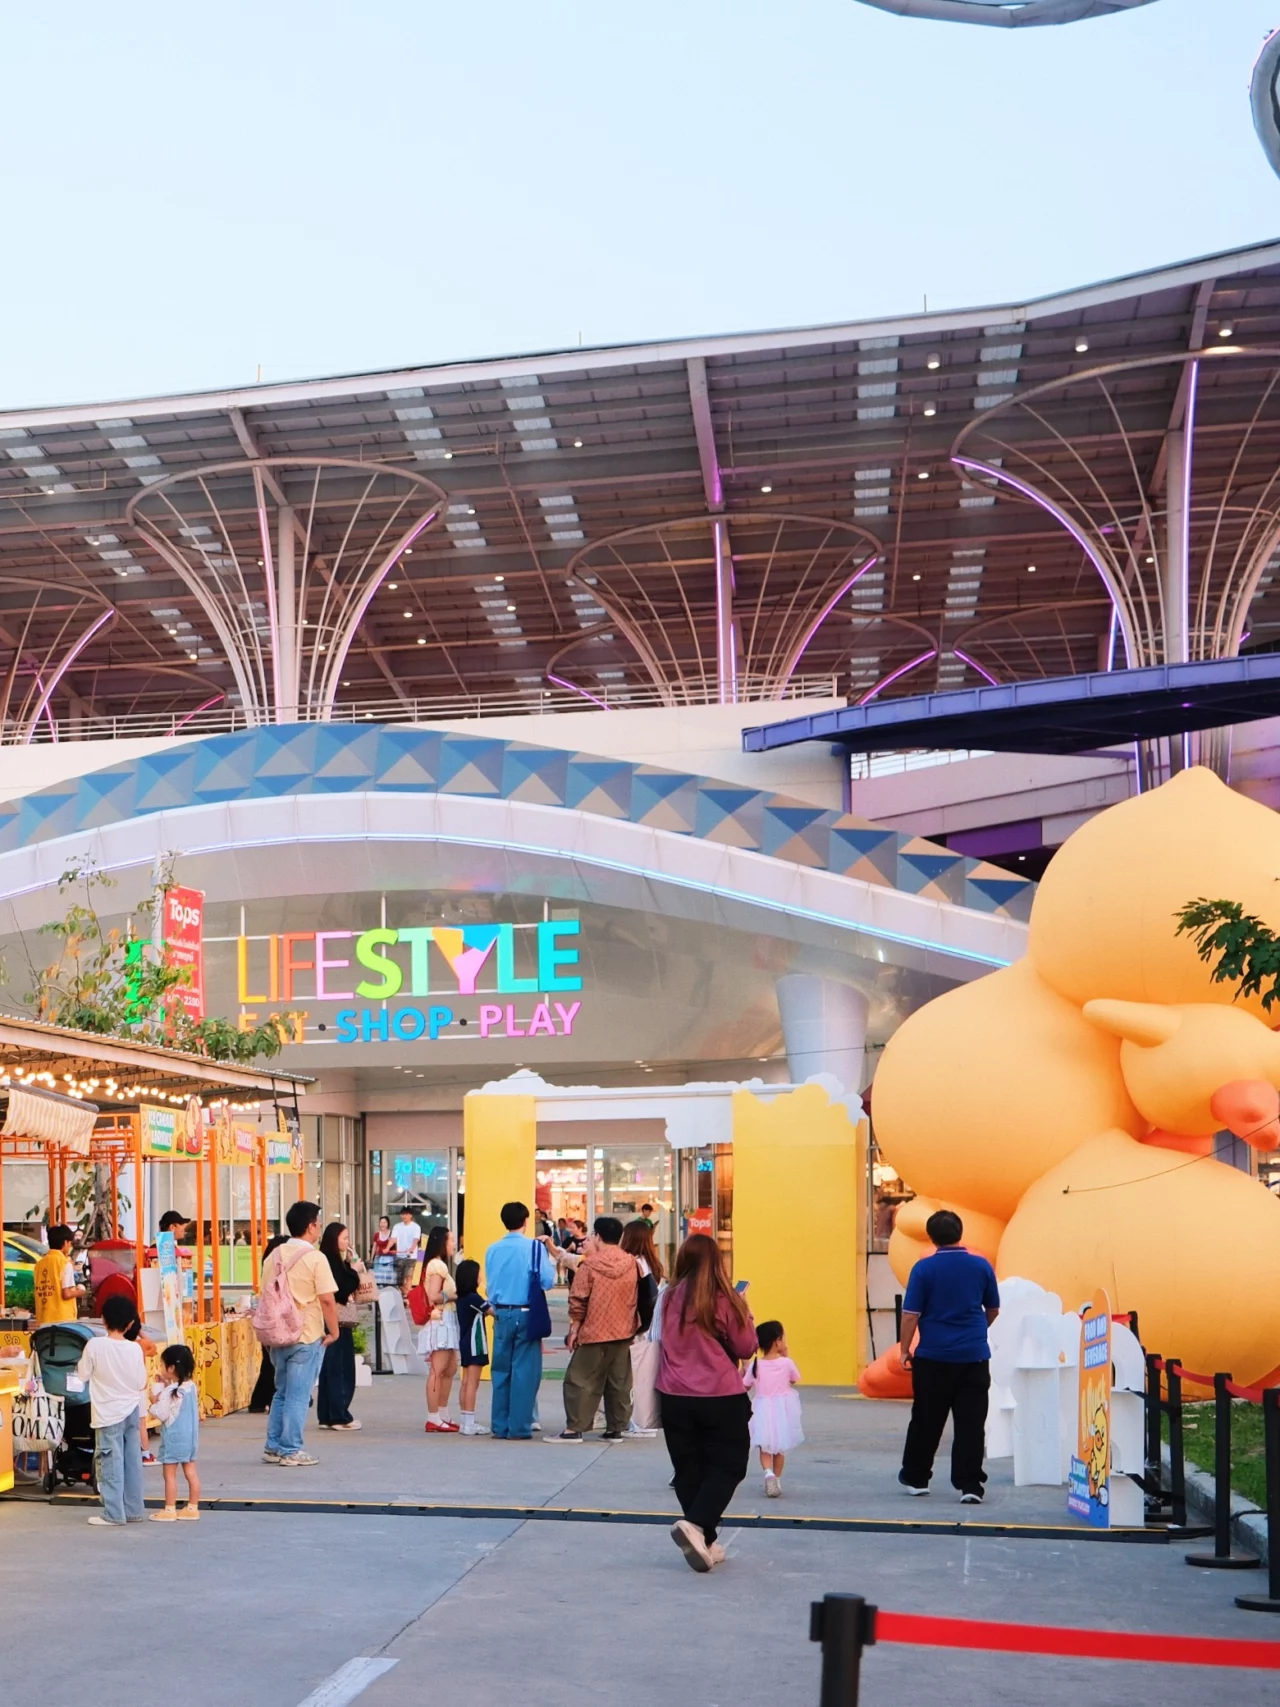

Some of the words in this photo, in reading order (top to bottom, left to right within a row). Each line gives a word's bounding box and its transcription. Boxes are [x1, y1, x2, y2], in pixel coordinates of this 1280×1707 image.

[169, 898, 201, 929] Tops
[237, 920, 583, 1004] LIFESTYLE
[336, 1006, 453, 1043] SHOP
[479, 1001, 582, 1038] PLAY
[690, 1217, 712, 1231] Tops
[12, 1415, 66, 1440] OMAN
